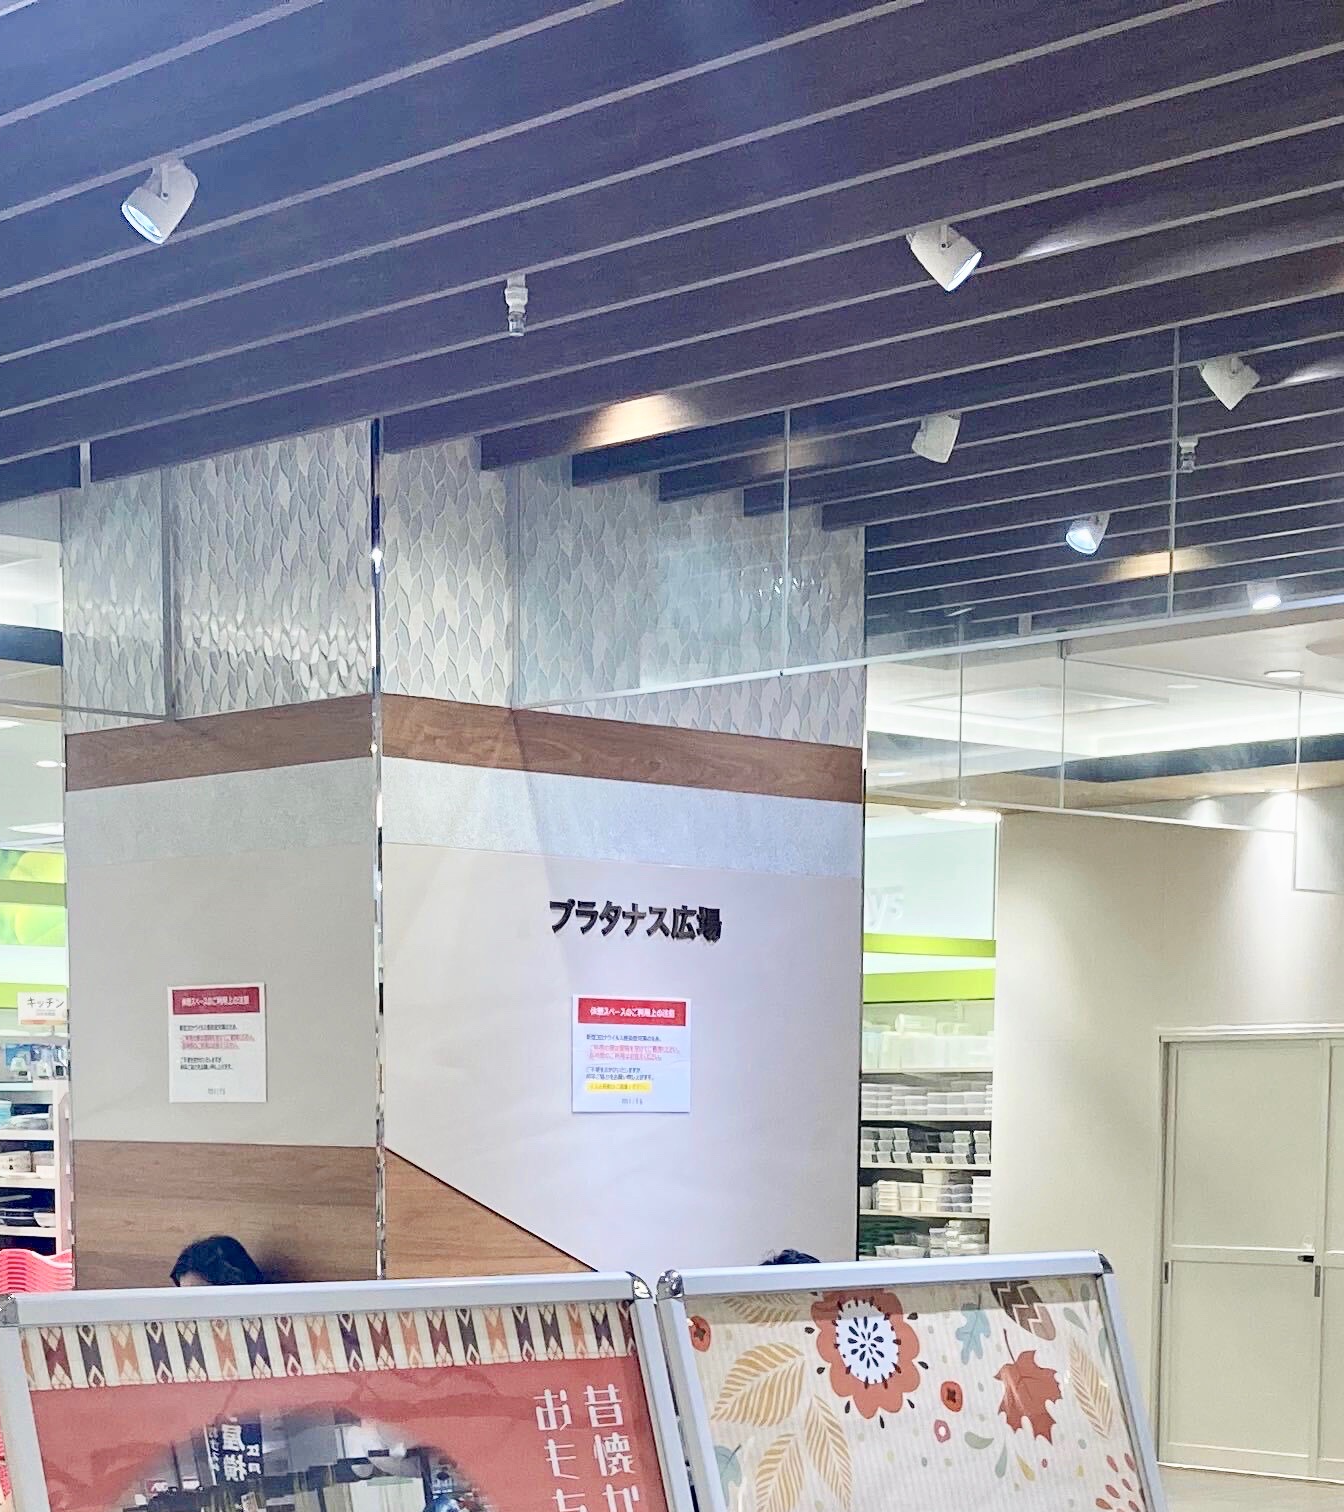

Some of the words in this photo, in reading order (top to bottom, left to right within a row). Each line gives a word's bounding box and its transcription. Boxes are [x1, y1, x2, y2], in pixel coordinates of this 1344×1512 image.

[549, 898, 724, 944] プラタナス広場
[26, 996, 65, 1009] キッチン
